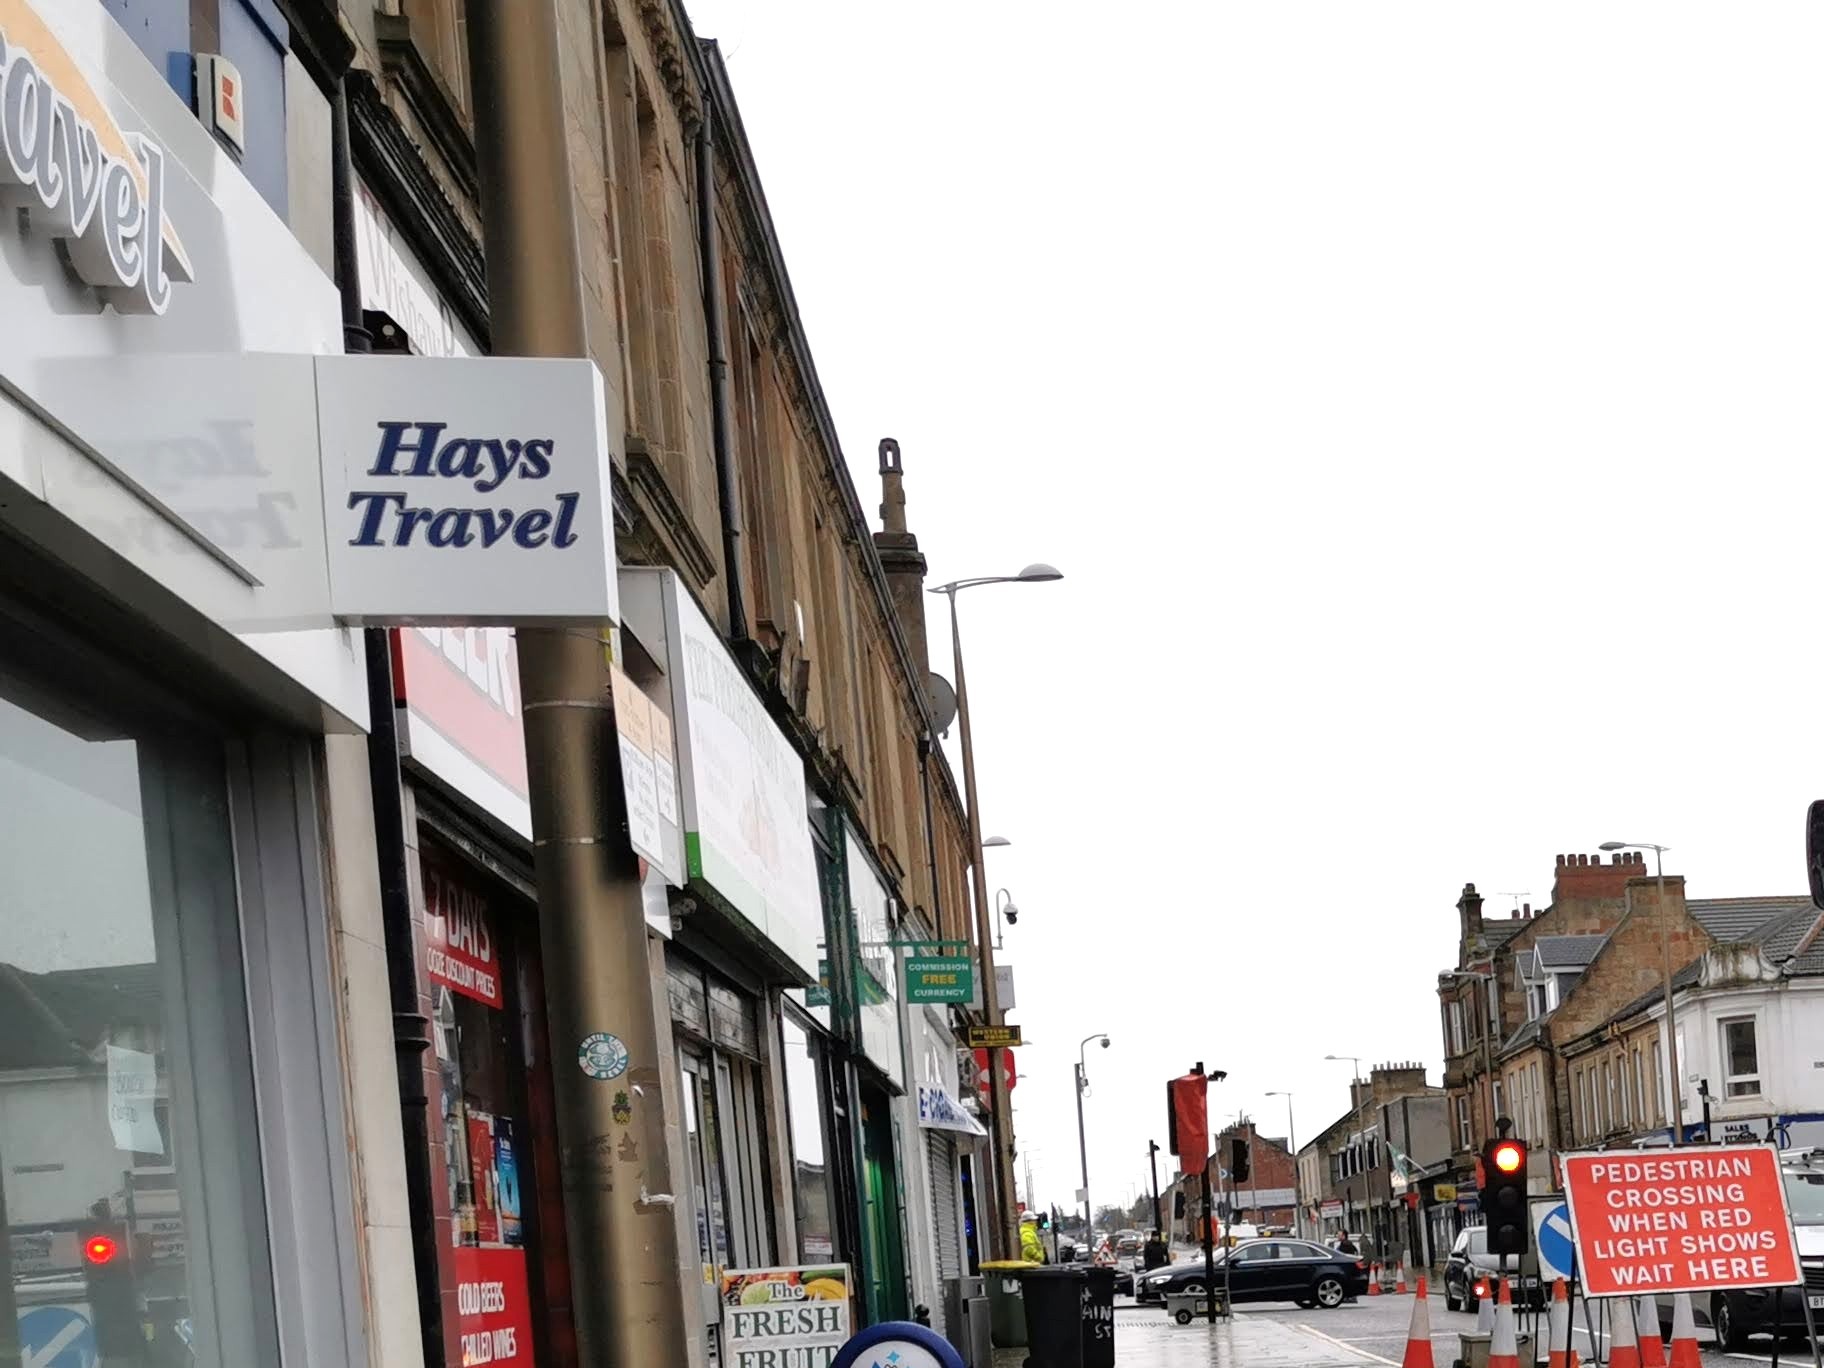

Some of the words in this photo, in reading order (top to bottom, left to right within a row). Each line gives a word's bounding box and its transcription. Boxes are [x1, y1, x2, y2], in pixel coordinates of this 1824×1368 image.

[0, 40, 171, 316] avel
[367, 421, 554, 492] Hays
[347, 492, 580, 549] Travel
[447, 879, 491, 963] DAYS
[908, 963, 969, 971] COMMISSION
[921, 974, 957, 984] FREE
[914, 988, 966, 997] CURRENCY
[1724, 1123, 1750, 1133] SALES
[1590, 1156, 1752, 1184] PEDESTRIAN
[1606, 1183, 1745, 1209] CROSSING
[1608, 1211, 1688, 1233] WHEN
[1700, 1207, 1752, 1229] RED
[1594, 1236, 1669, 1259] LIGHT
[1680, 1230, 1777, 1255] SHOWS
[1610, 1264, 1675, 1286] WAIT
[1687, 1256, 1770, 1281] HERE
[458, 1282, 480, 1316] COLD
[480, 1281, 505, 1313] BEERS
[767, 1281, 804, 1300] The
[732, 1306, 841, 1340] FRESH
[1081, 1304, 1112, 1321] AIN
[461, 1331, 492, 1368] CHILLED
[492, 1326, 517, 1360] WINES
